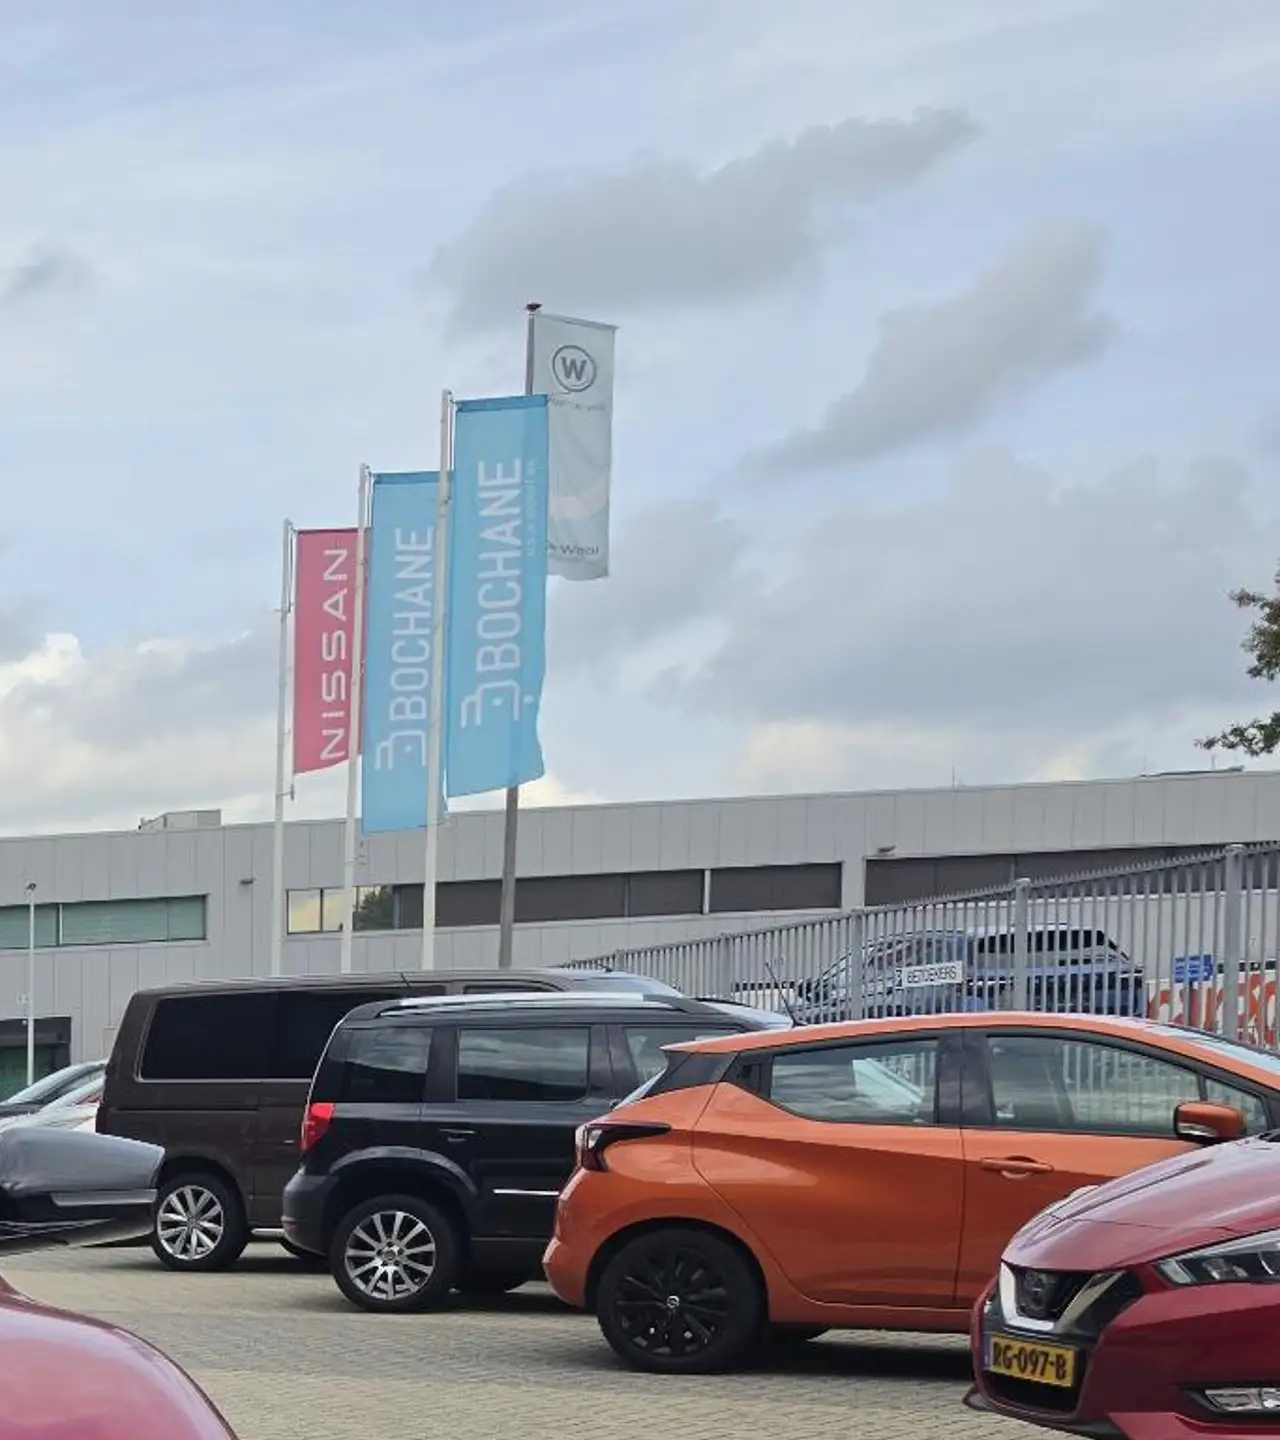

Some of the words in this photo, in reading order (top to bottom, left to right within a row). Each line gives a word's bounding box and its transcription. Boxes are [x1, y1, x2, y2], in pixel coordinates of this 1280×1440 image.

[320, 549, 348, 761] NISSAN
[389, 526, 434, 722] BOCHANE
[475, 459, 522, 679] BOCHANE
[993, 1341, 1067, 1381] RG-097-B
